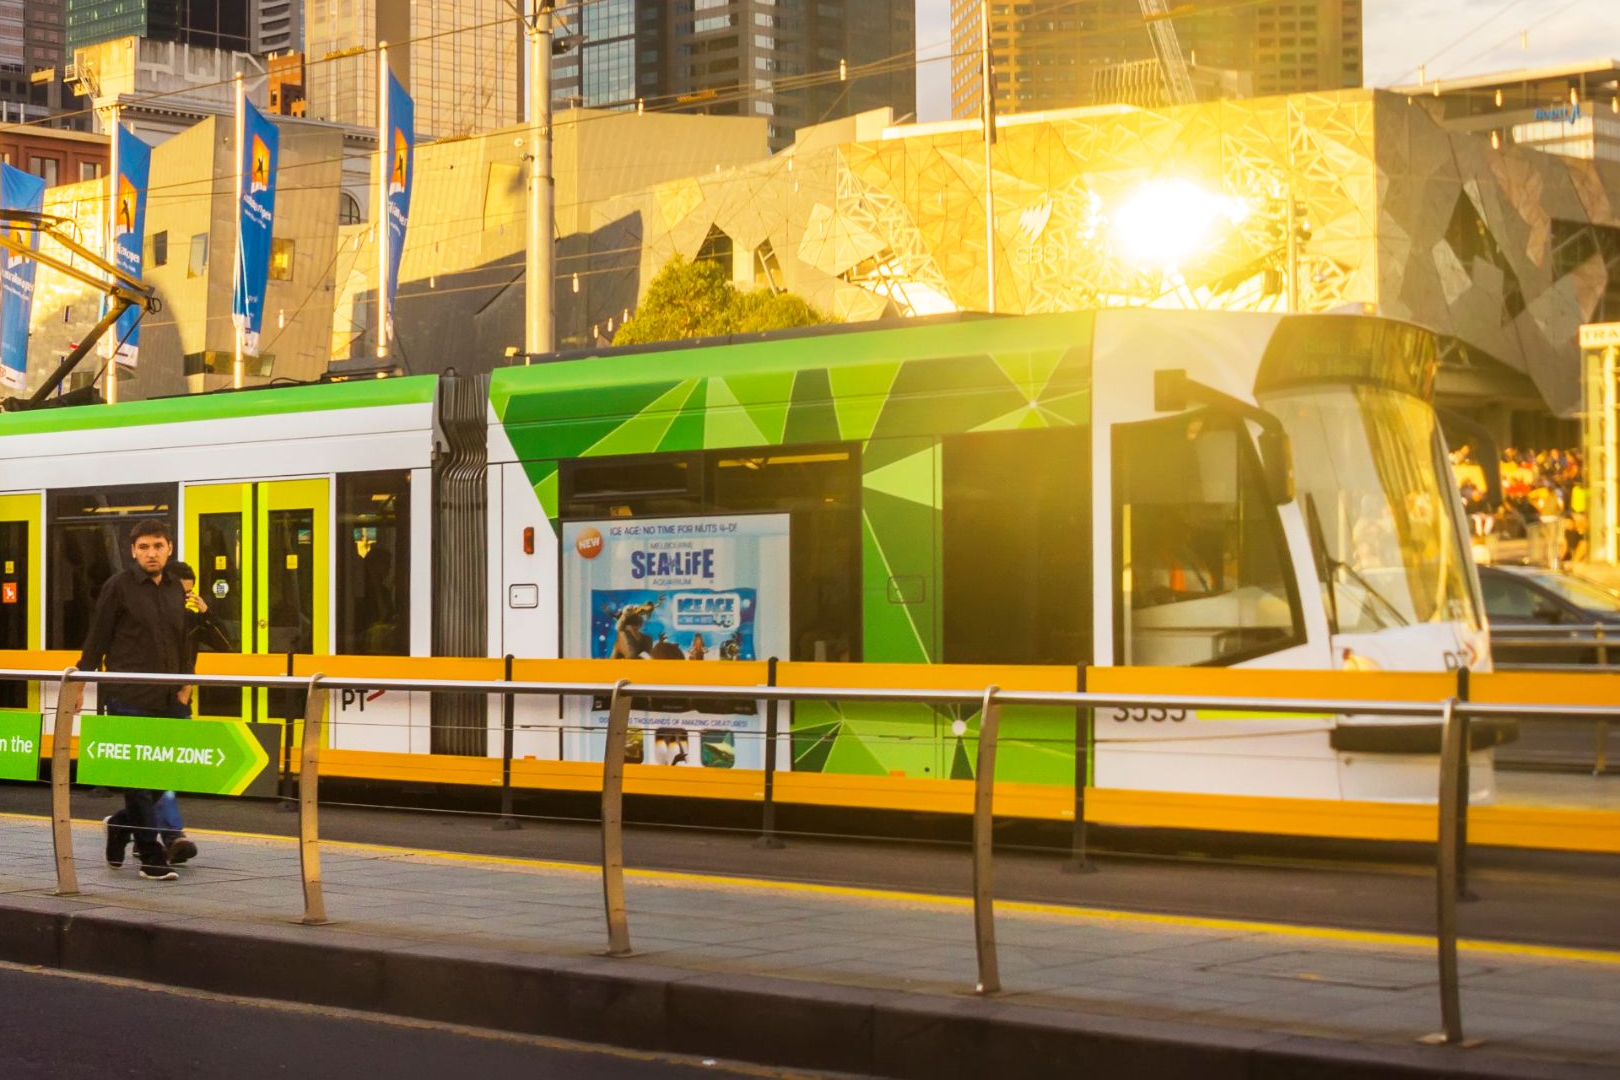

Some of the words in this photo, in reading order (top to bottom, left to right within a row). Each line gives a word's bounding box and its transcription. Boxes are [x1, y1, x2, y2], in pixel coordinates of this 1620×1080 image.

[643, 526, 656, 536] NO
[677, 524, 693, 534] FOR
[579, 536, 601, 550] NEW
[11, 734, 34, 754] the
[97, 742, 132, 760] FREE
[134, 744, 175, 763] TRAM
[176, 747, 214, 765] ZONE
